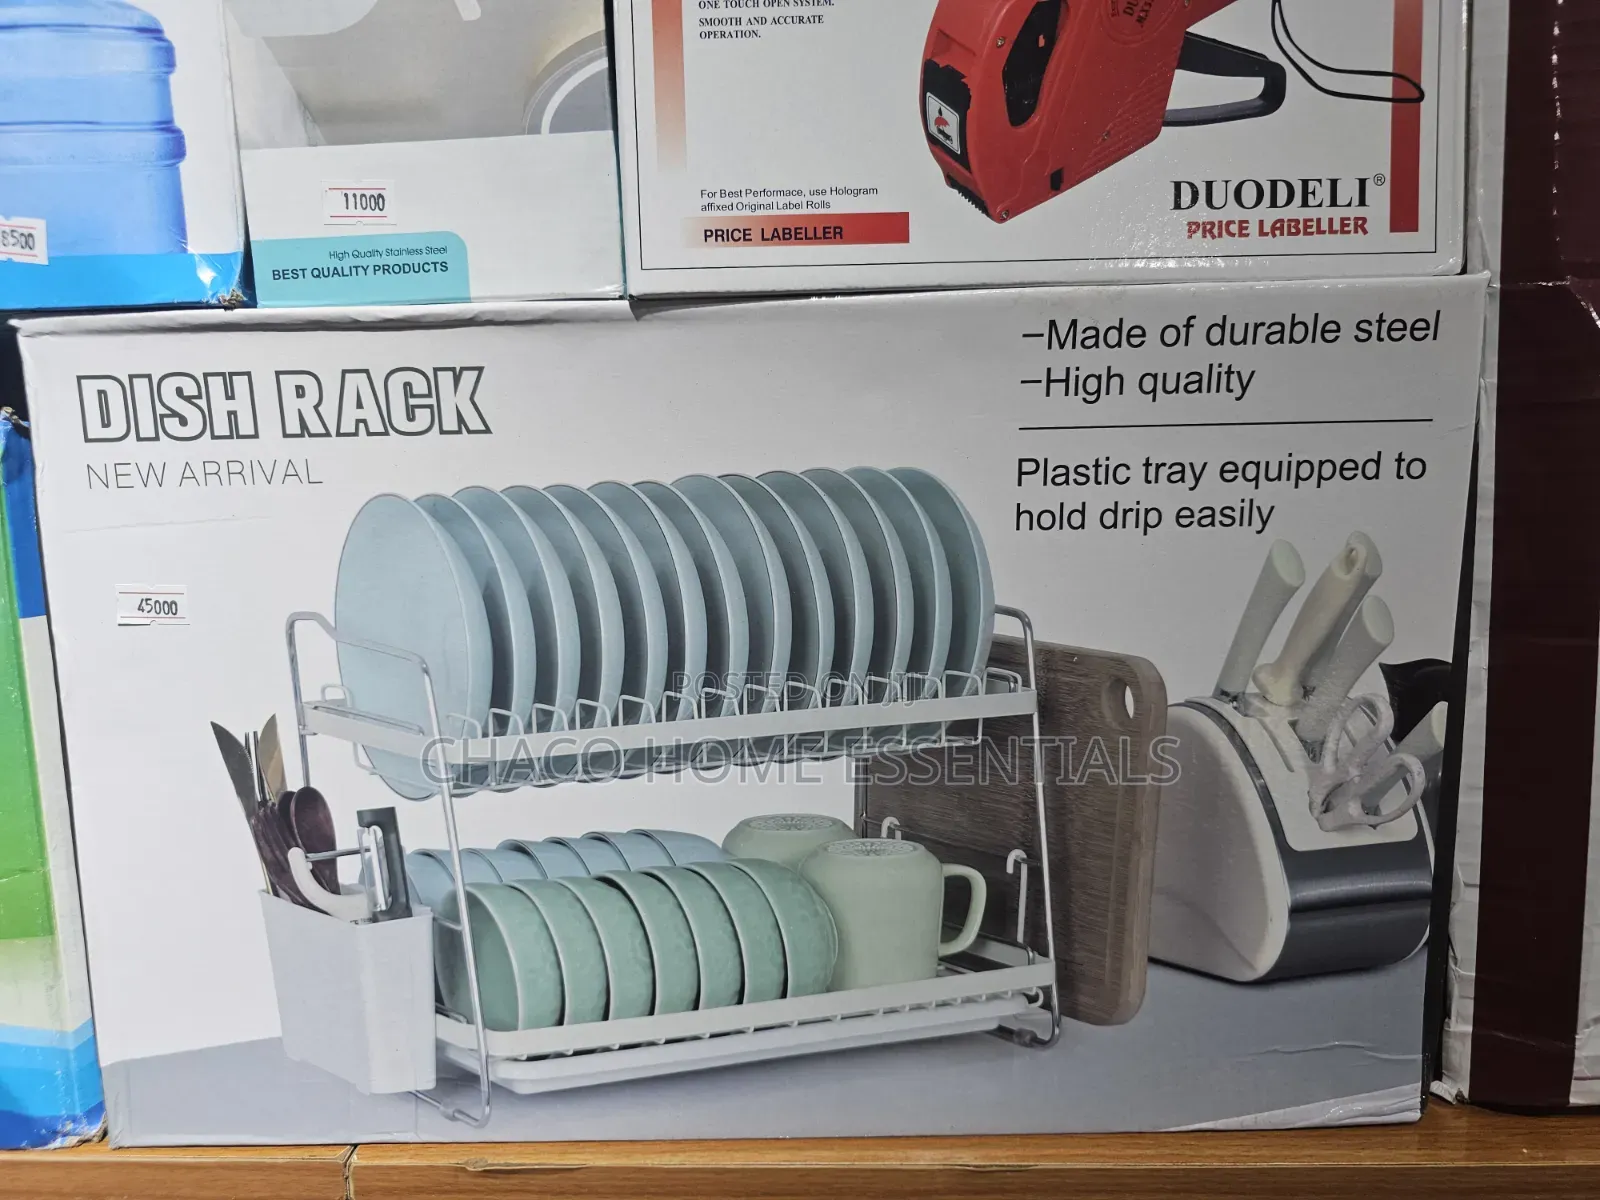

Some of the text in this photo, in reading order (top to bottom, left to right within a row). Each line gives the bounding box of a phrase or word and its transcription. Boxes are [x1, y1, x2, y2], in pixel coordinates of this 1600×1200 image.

[698, 0, 720, 9] ONE
[724, 0, 759, 9] TOUCH
[763, 0, 790, 8] OPEN
[699, 14, 825, 27] SMOOTH AND ACCURATE
[699, 29, 761, 39] OPERATION.
[343, 192, 385, 211] 11000
[700, 186, 878, 199] For Best Performace, use Hologram
[700, 199, 831, 212] affixed Original Label Rolls
[704, 226, 843, 243] PRICE LABELLER
[1186, 216, 1369, 240] PRICE LABELLER
[329, 245, 448, 262] High Quality Stainless Steel
[272, 261, 449, 281] BEST QUALITY PRODUCTS
[1159, 315, 1197, 347] of
[1205, 313, 1341, 347] durable
[1353, 310, 1441, 343] steel
[1138, 363, 1256, 402] quality
[76, 366, 493, 444] DISH RACK
[86, 458, 324, 490] NEW ARRIVAL
[1017, 450, 1427, 491] Plastic tray equipped to
[1014, 498, 1275, 536] hold drip easily
[137, 597, 178, 616] 45000
